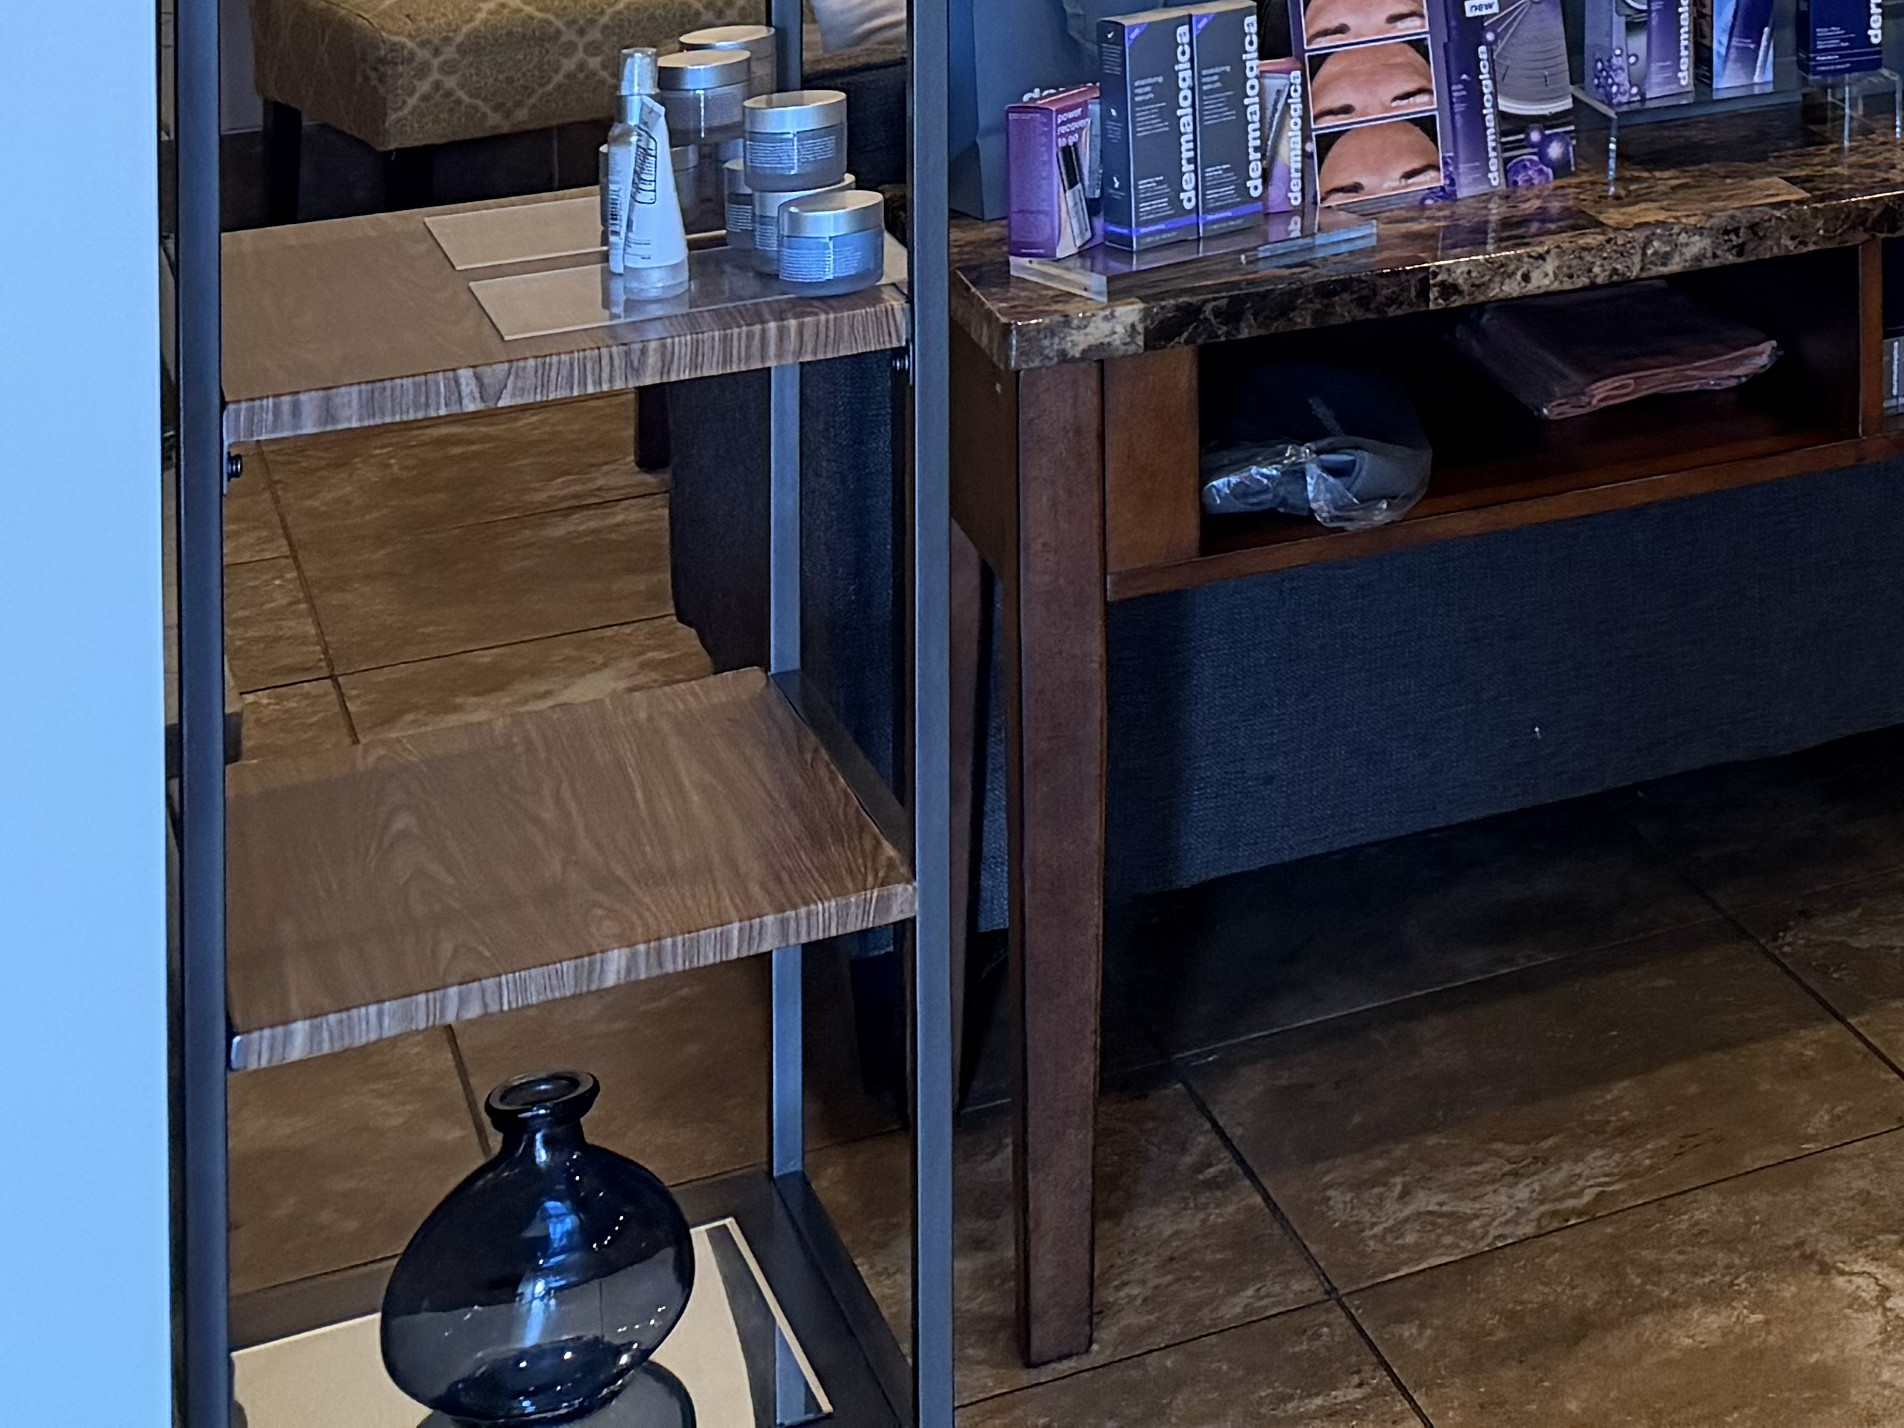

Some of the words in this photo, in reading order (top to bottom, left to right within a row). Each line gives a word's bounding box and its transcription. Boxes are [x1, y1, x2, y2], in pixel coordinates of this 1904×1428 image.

[1469, 1, 1496, 13] new
[1057, 107, 1083, 124] power
[1057, 118, 1092, 135] recovery
[1175, 24, 1197, 211] dermalogica
[1243, 14, 1263, 198] dermalogica
[1287, 70, 1302, 206] dermalogica
[1478, 45, 1499, 187] dermalogica
